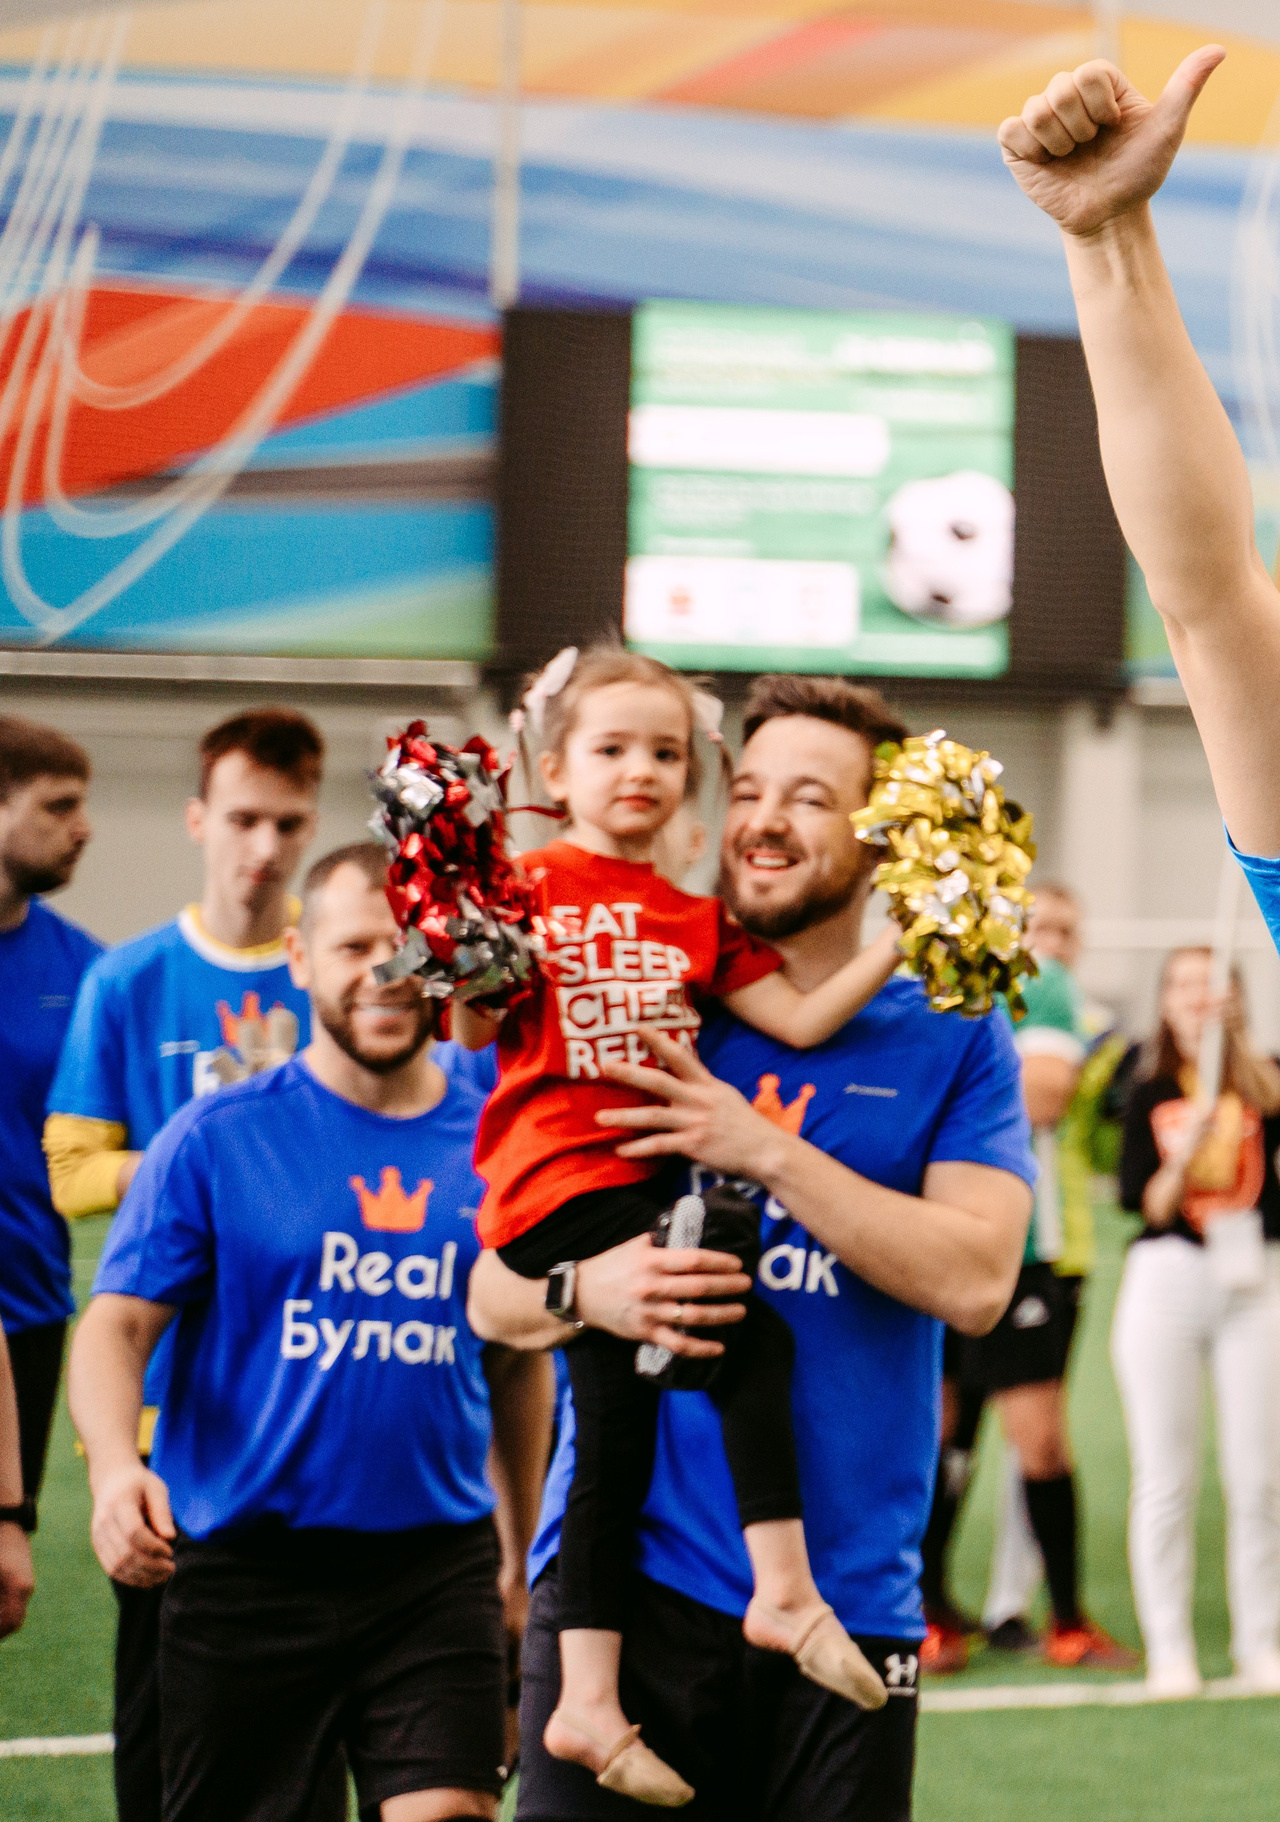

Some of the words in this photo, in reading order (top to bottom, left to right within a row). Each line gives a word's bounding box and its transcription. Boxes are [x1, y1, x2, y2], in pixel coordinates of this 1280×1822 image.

[557, 939, 691, 984] SLEEP
[319, 1231, 458, 1301] Real
[280, 1299, 458, 1372] Булак
